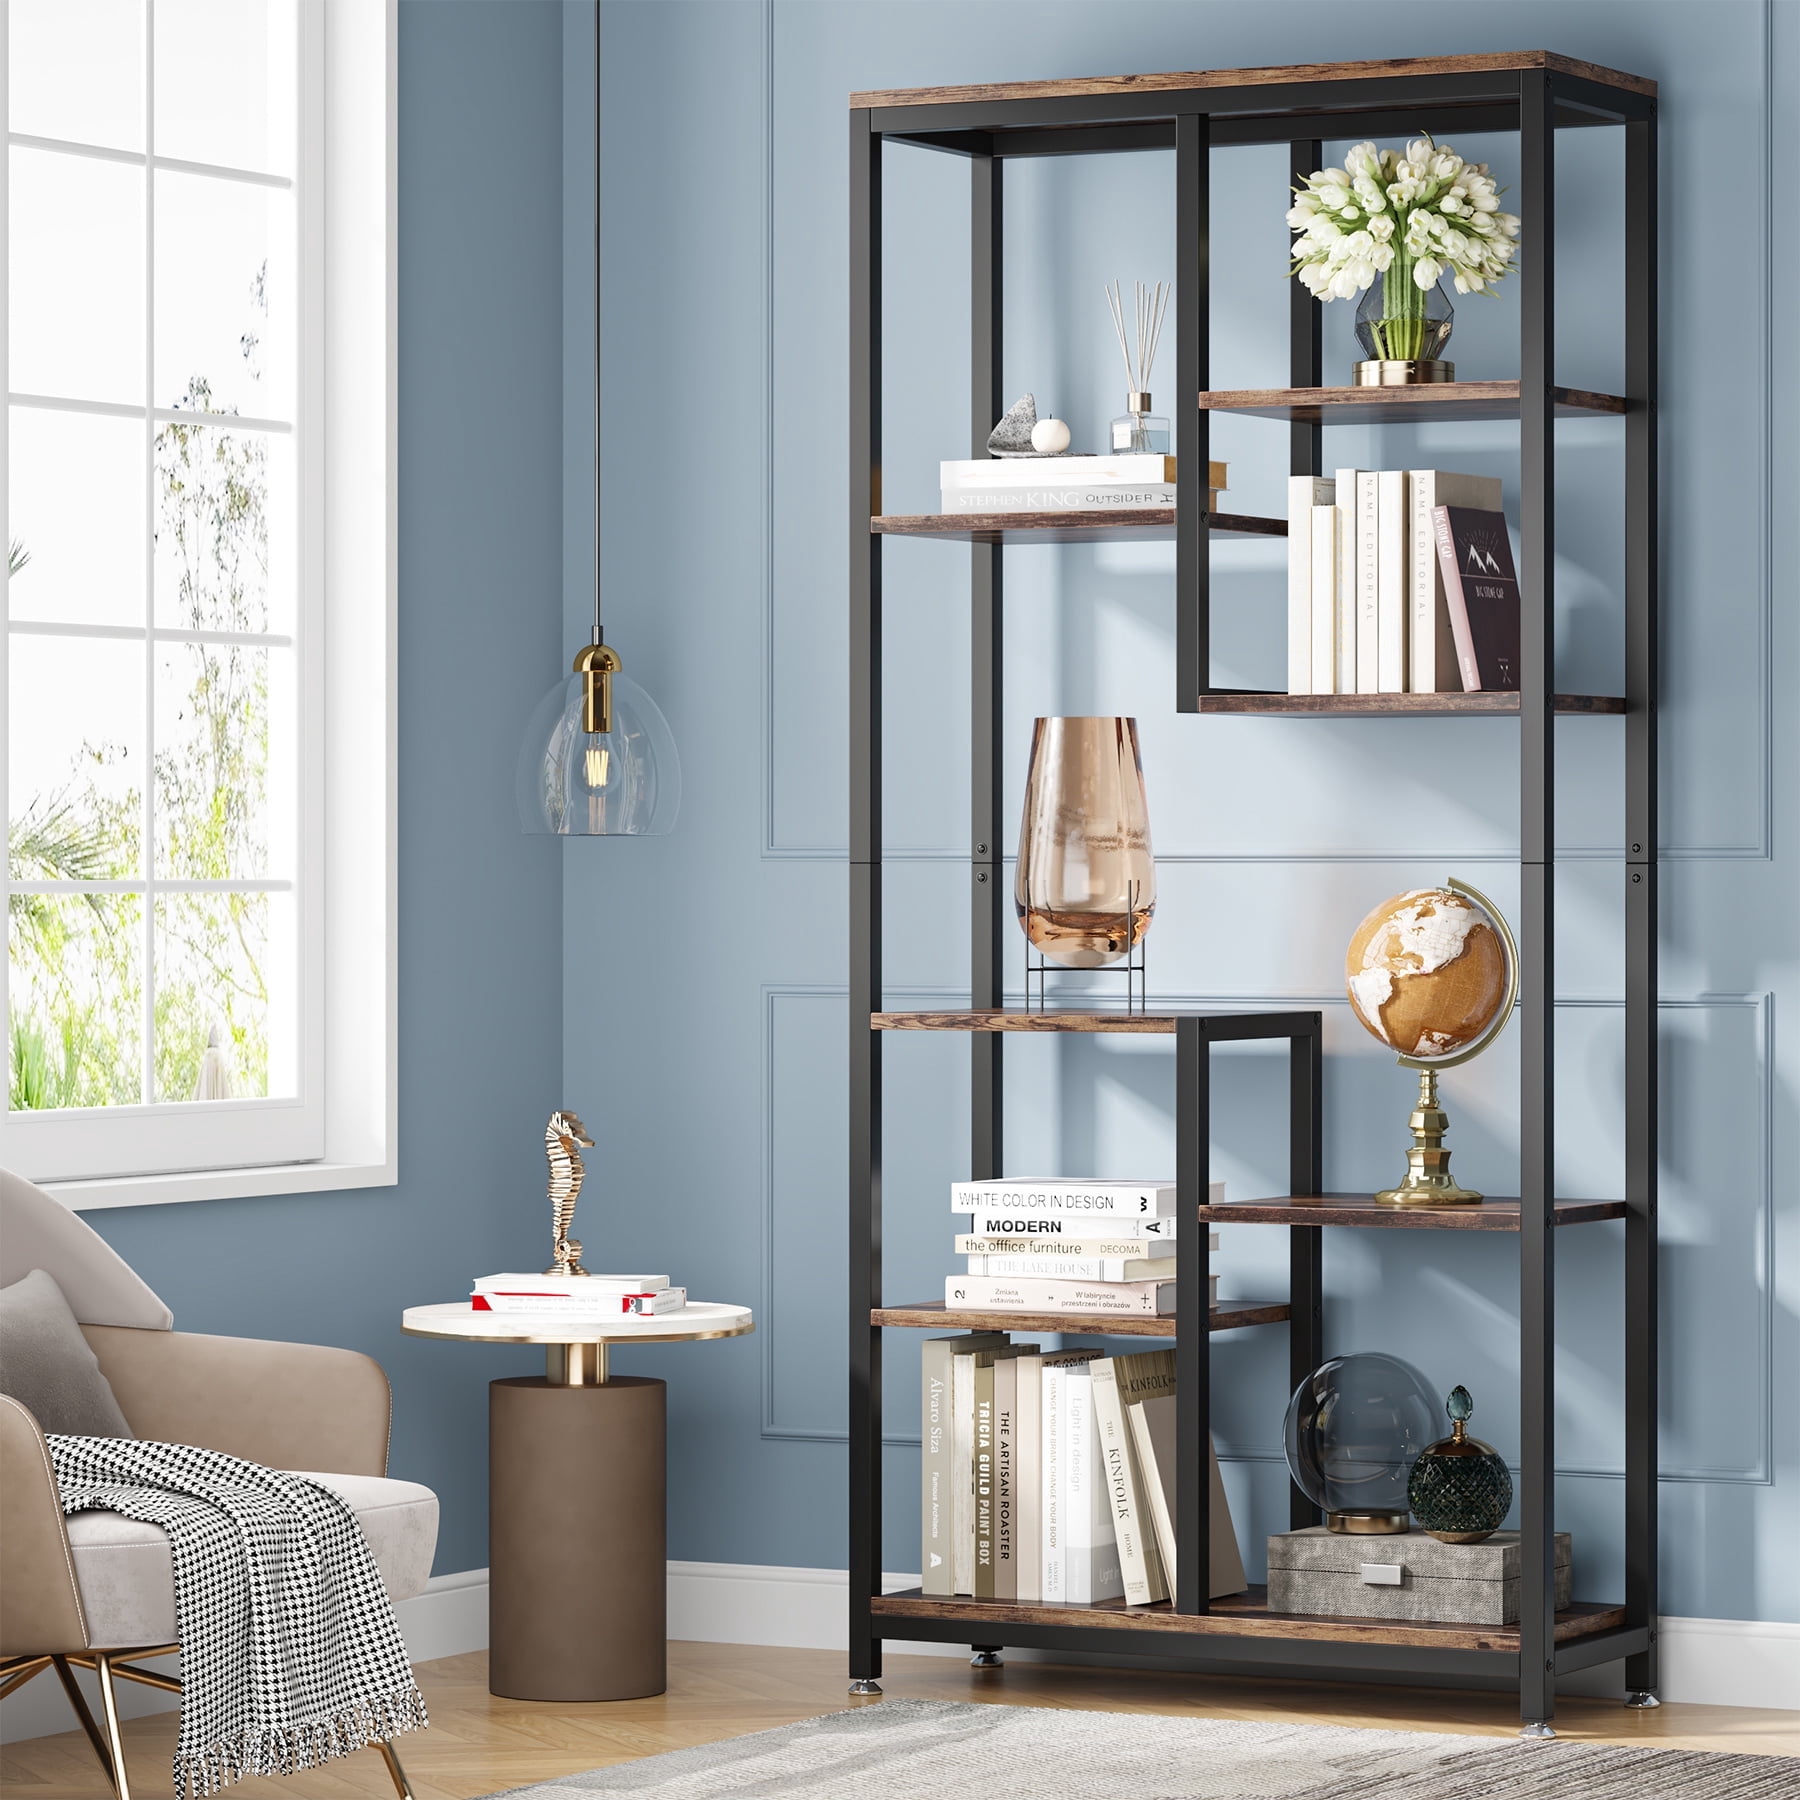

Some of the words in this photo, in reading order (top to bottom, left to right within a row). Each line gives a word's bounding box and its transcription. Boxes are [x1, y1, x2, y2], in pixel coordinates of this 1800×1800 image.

[959, 494, 1023, 507] STEPHEN
[1026, 491, 1080, 508] KING
[1085, 493, 1153, 505] OUTSIDER
[1366, 479, 1374, 521] NAME
[1418, 477, 1426, 519] NAME
[1366, 532, 1374, 621] EDITORIAL
[1418, 530, 1426, 620] EDITORIAL
[959, 1192, 999, 1207] WHITE
[1002, 1193, 1047, 1208] COLOR
[1050, 1195, 1062, 1208] IN
[1066, 1195, 1114, 1210] DESIGN
[986, 1219, 1062, 1233] MODERN
[1145, 1221, 1161, 1234] A
[965, 1239, 985, 1251] the
[1029, 1240, 1082, 1254] furniture
[1100, 1244, 1141, 1254] DECOMA
[1054, 1263, 1093, 1276] HOUSE
[954, 1289, 966, 1300] 2
[1130, 1374, 1169, 1393] KINFOLK
[979, 1401, 990, 1448] TRICIA
[1000, 1411, 1010, 1435] THE
[1071, 1397, 1082, 1429] Light
[930, 1426, 943, 1453] Siza
[1072, 1433, 1082, 1445] in
[979, 1454, 990, 1495] GUILD
[1000, 1441, 1010, 1497] ARTISAN
[1071, 1448, 1082, 1492] design
[1108, 1448, 1130, 1519] KINFOLK
[1123, 1533, 1134, 1558] HOME
[979, 1499, 990, 1536] PAINT
[1000, 1501, 1010, 1560] ROASTER
[979, 1540, 990, 1566] BOX
